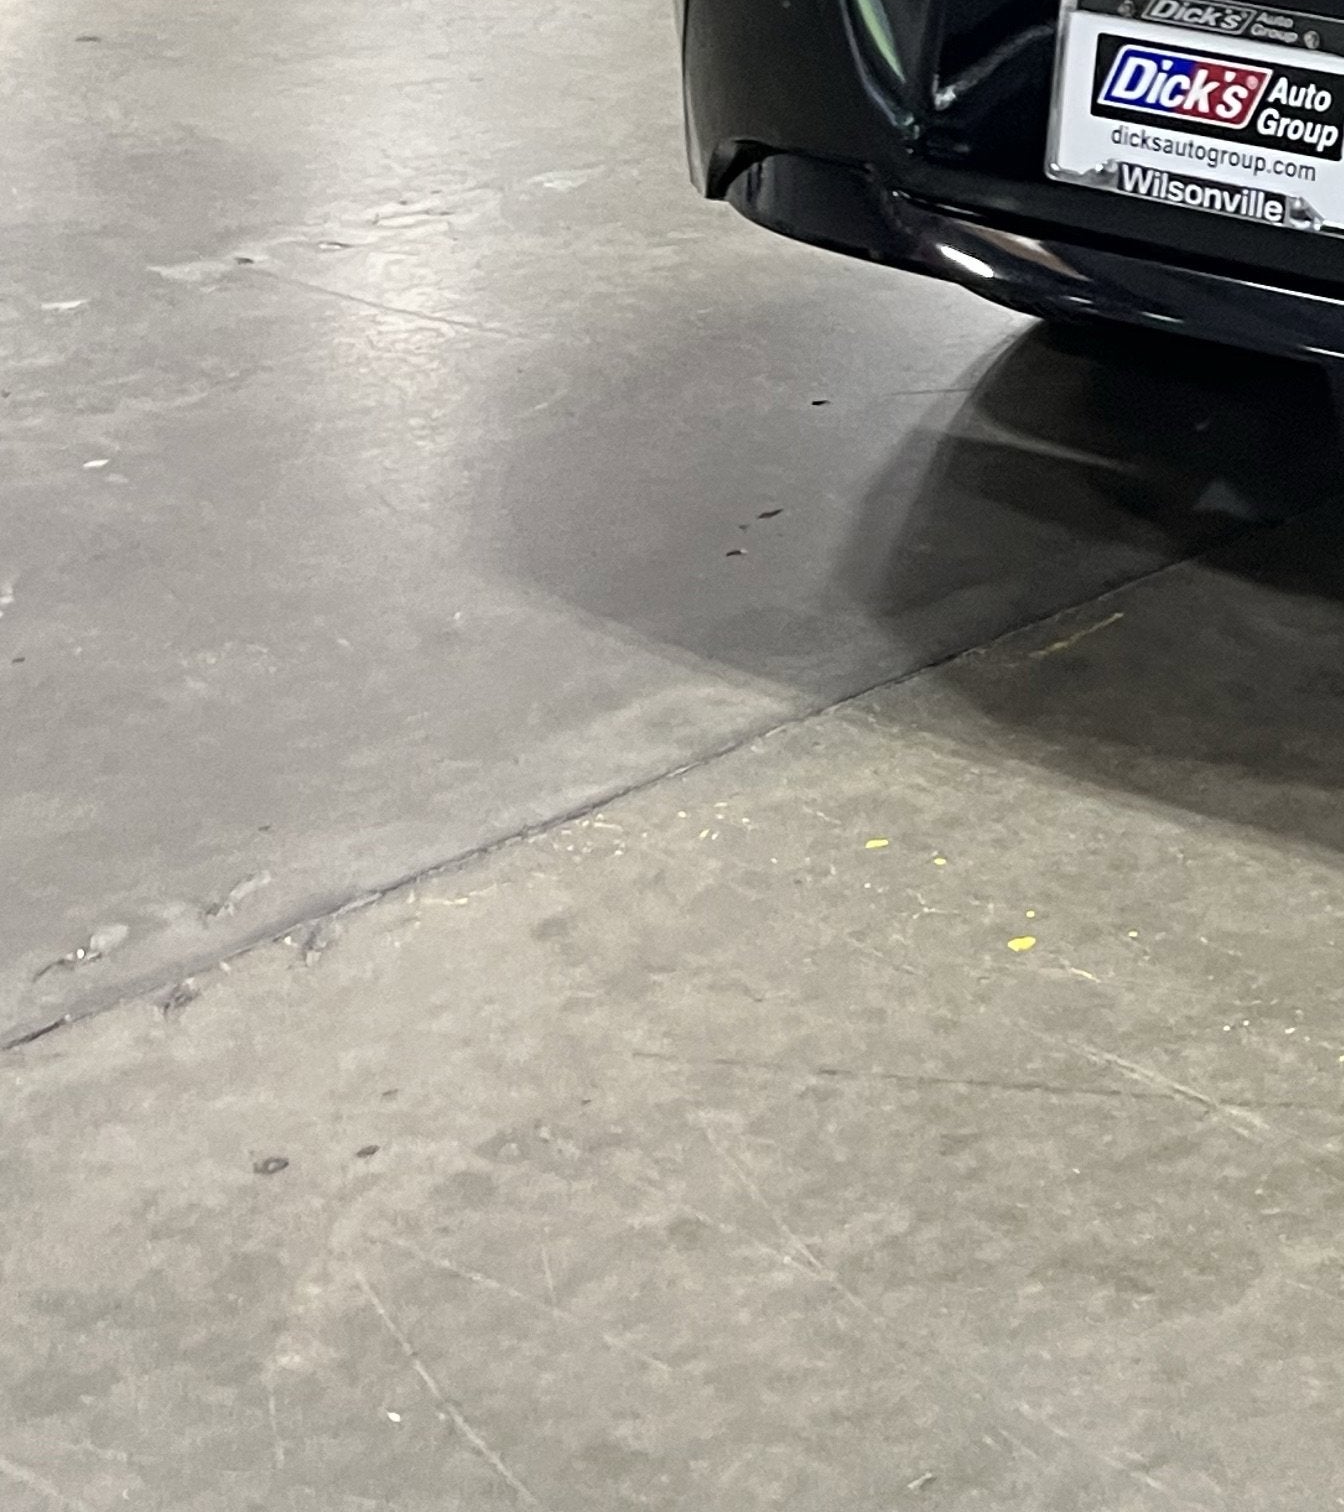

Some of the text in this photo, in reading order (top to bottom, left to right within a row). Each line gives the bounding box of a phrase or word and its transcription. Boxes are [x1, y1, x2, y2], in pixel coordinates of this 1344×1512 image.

[1151, 0, 1242, 29] Dick's
[1257, 12, 1294, 28] Auto
[1110, 55, 1250, 120] Dick's
[1267, 76, 1332, 113] Auto
[1256, 108, 1339, 152] Group
[1110, 124, 1317, 182] dicksautogroup.com
[1121, 164, 1285, 224] Wilsonville
